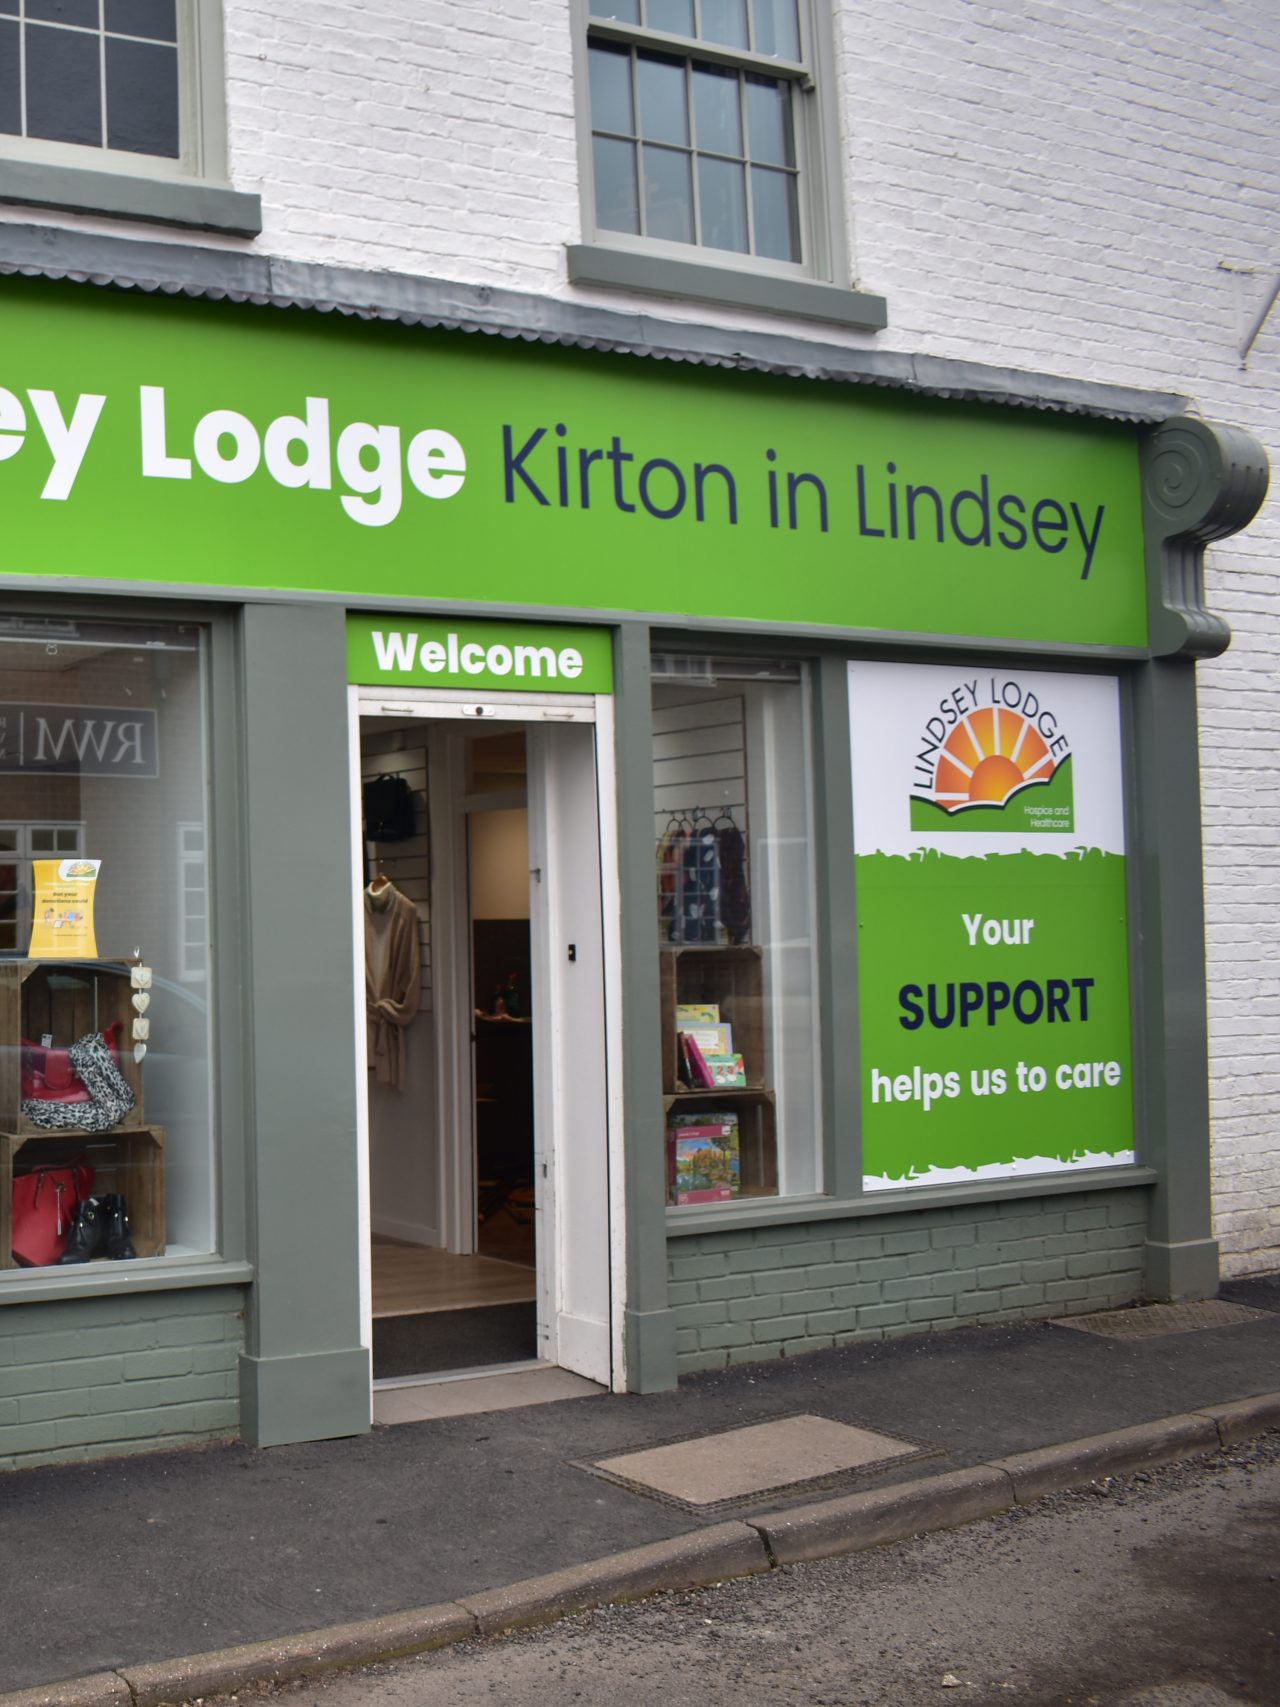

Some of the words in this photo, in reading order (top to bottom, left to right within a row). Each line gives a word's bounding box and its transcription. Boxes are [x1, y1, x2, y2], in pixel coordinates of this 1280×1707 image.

[140, 385, 466, 526] Lodge
[502, 422, 738, 526] Kirton
[766, 448, 829, 533] in
[856, 461, 1105, 580] Lindsey
[371, 631, 583, 679] Welcome
[914, 680, 978, 789] LINDSEY
[991, 678, 1069, 757] LODGE
[1023, 805, 1053, 818] Hospice
[1055, 805, 1070, 816] and
[1030, 817, 1070, 828] Healthcare
[961, 913, 1034, 946] Your
[898, 977, 1095, 1031] SUPPORT
[871, 1065, 961, 1112] helps
[970, 1067, 1008, 1096] us
[1015, 1061, 1048, 1093] to
[1055, 1060, 1121, 1090] care
